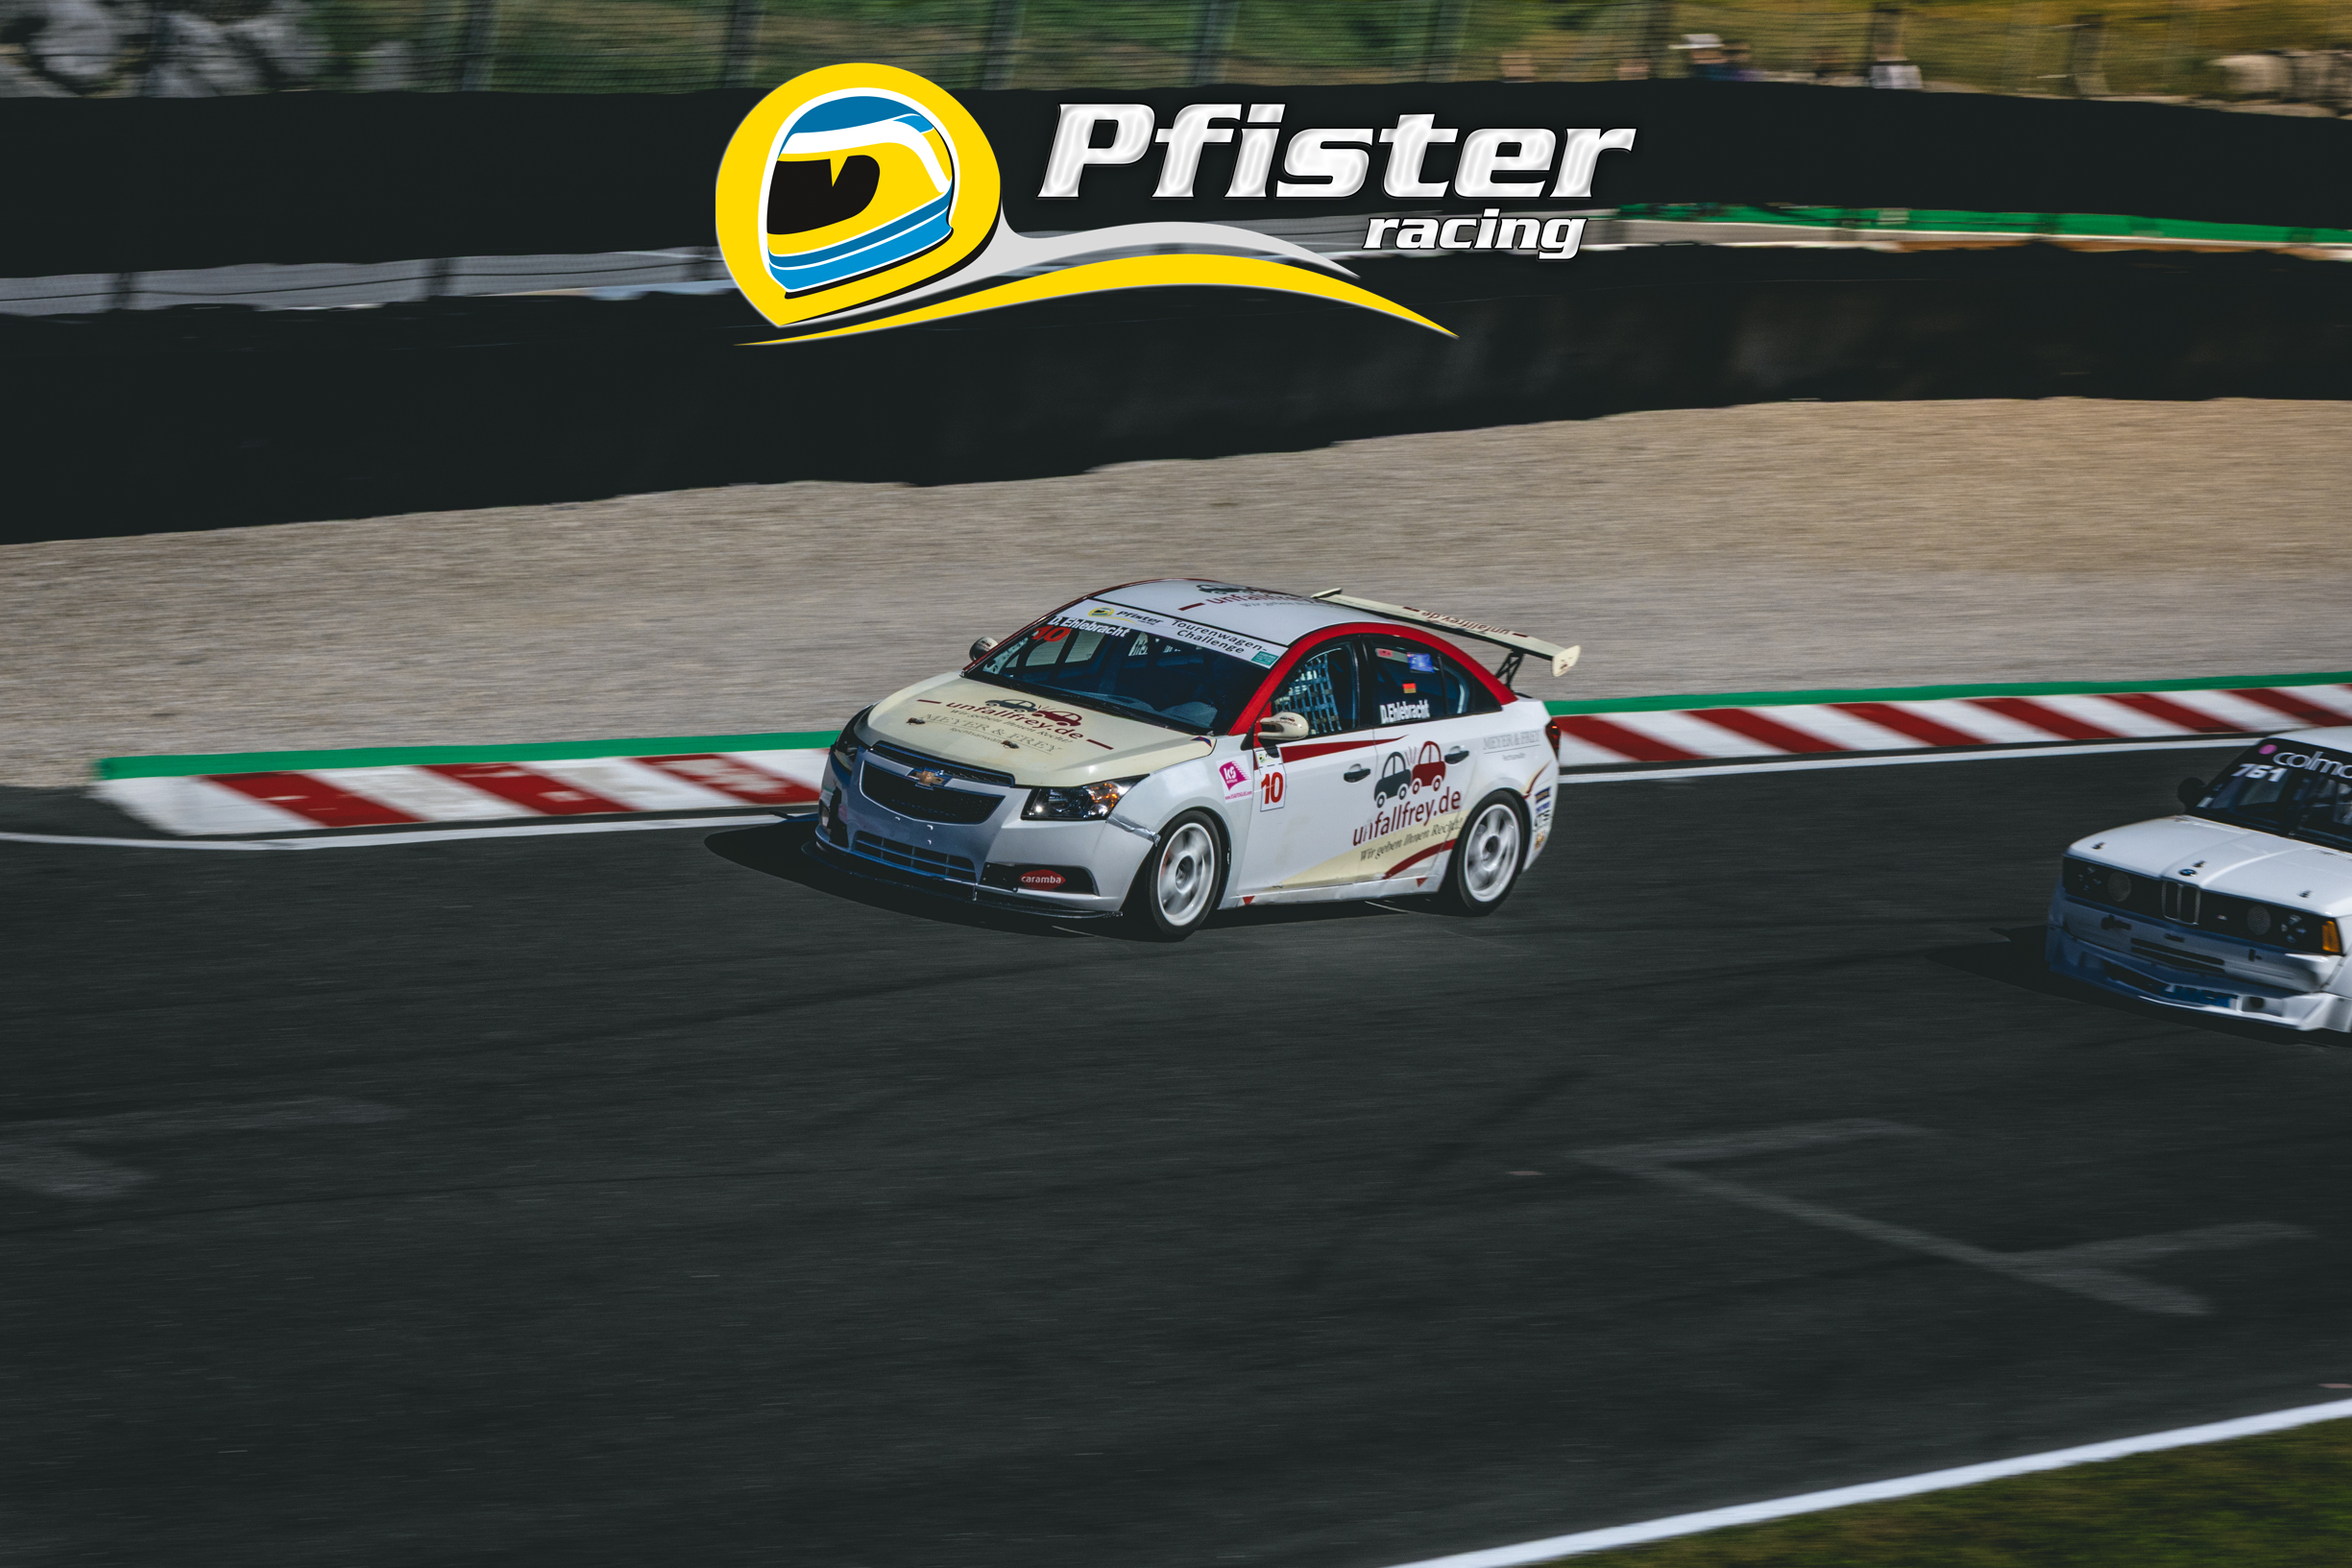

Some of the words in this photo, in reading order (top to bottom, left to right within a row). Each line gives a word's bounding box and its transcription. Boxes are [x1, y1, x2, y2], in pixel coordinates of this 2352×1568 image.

[1031, 625, 1072, 642] 10
[1047, 616, 1061, 626] D.
[1059, 617, 1131, 638] Ehlebracht
[1172, 619, 1268, 652] Tourenwagen-
[1176, 629, 1246, 654] Challenge
[919, 713, 990, 732] MEYER
[1007, 733, 1063, 752] FREY
[945, 702, 1083, 739] unfallfrey.de
[1261, 772, 1284, 805] 10
[1352, 786, 1462, 847] unfallfrey.de
[1021, 875, 1061, 884] caramba
